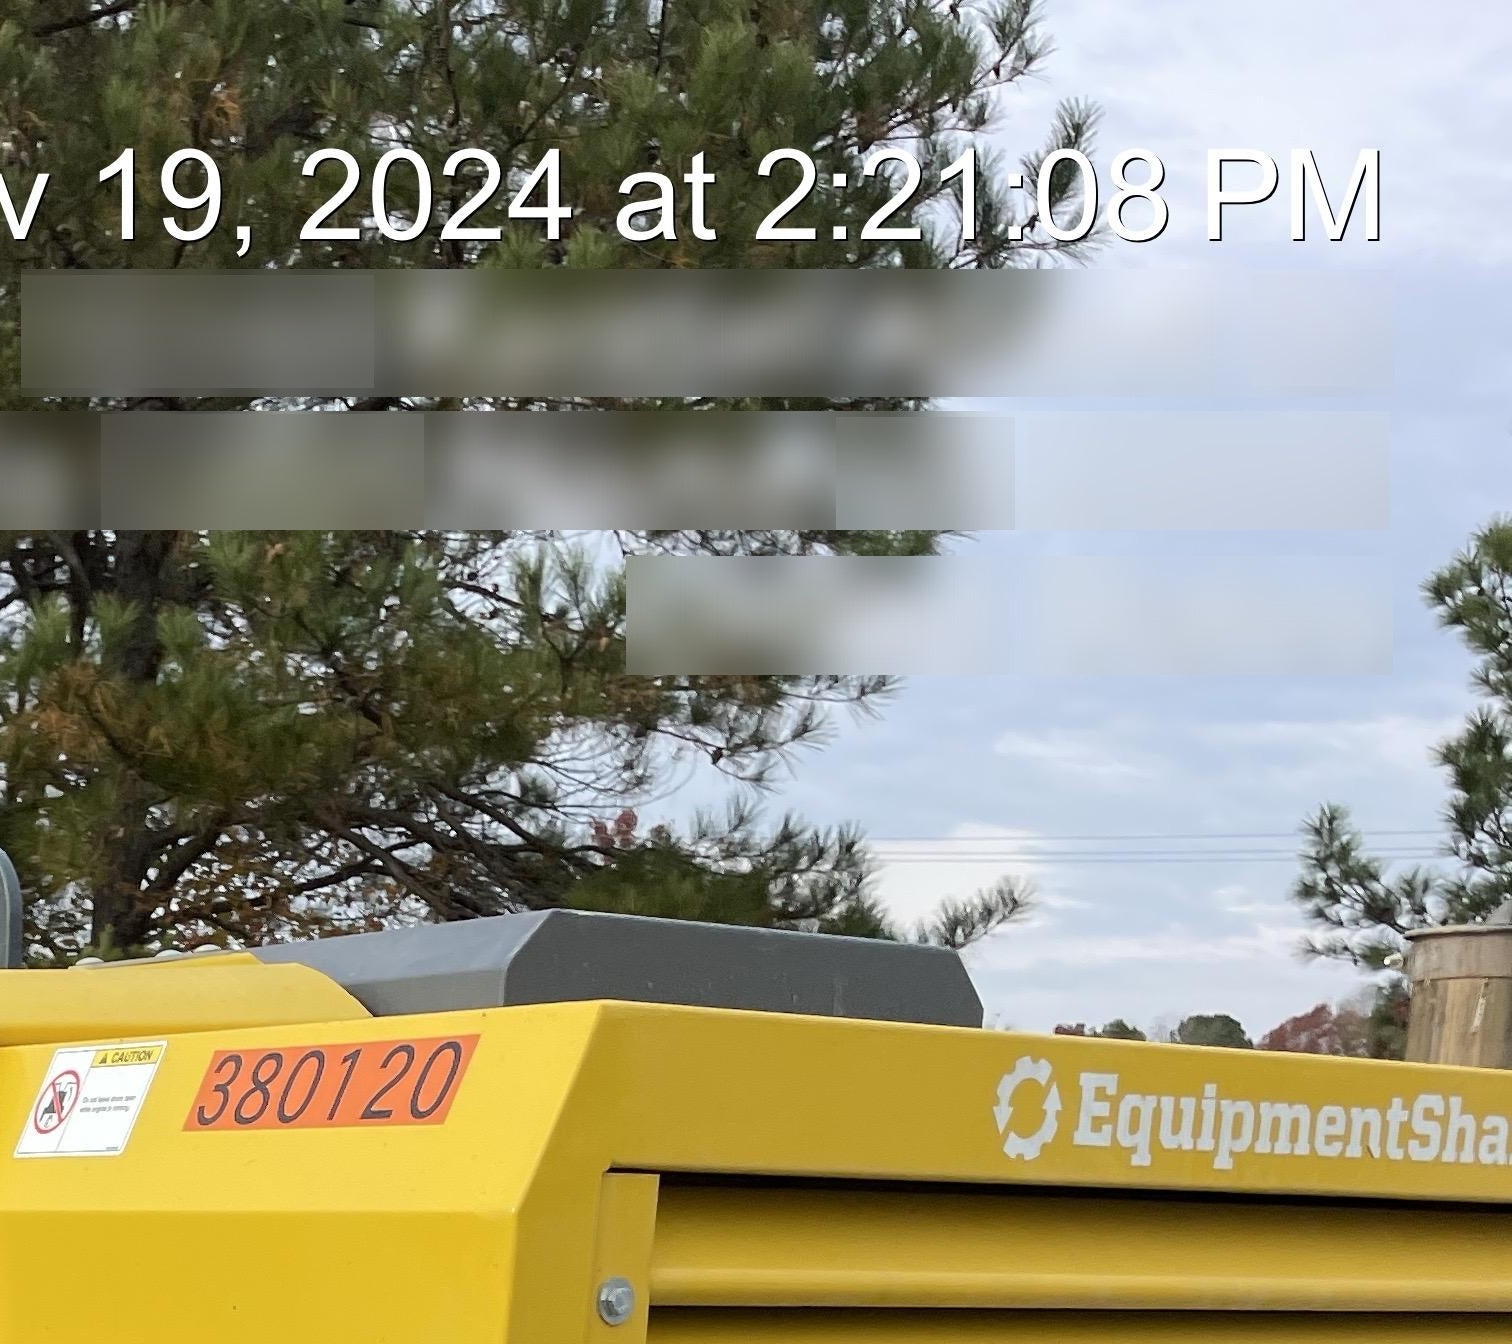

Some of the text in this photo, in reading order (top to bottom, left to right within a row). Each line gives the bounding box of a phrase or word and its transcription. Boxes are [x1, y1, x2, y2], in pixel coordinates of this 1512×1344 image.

[111, 1050, 154, 1064] CAUTION
[197, 1040, 463, 1126] 380120
[1073, 1072, 1512, 1170] EquipmentSha
